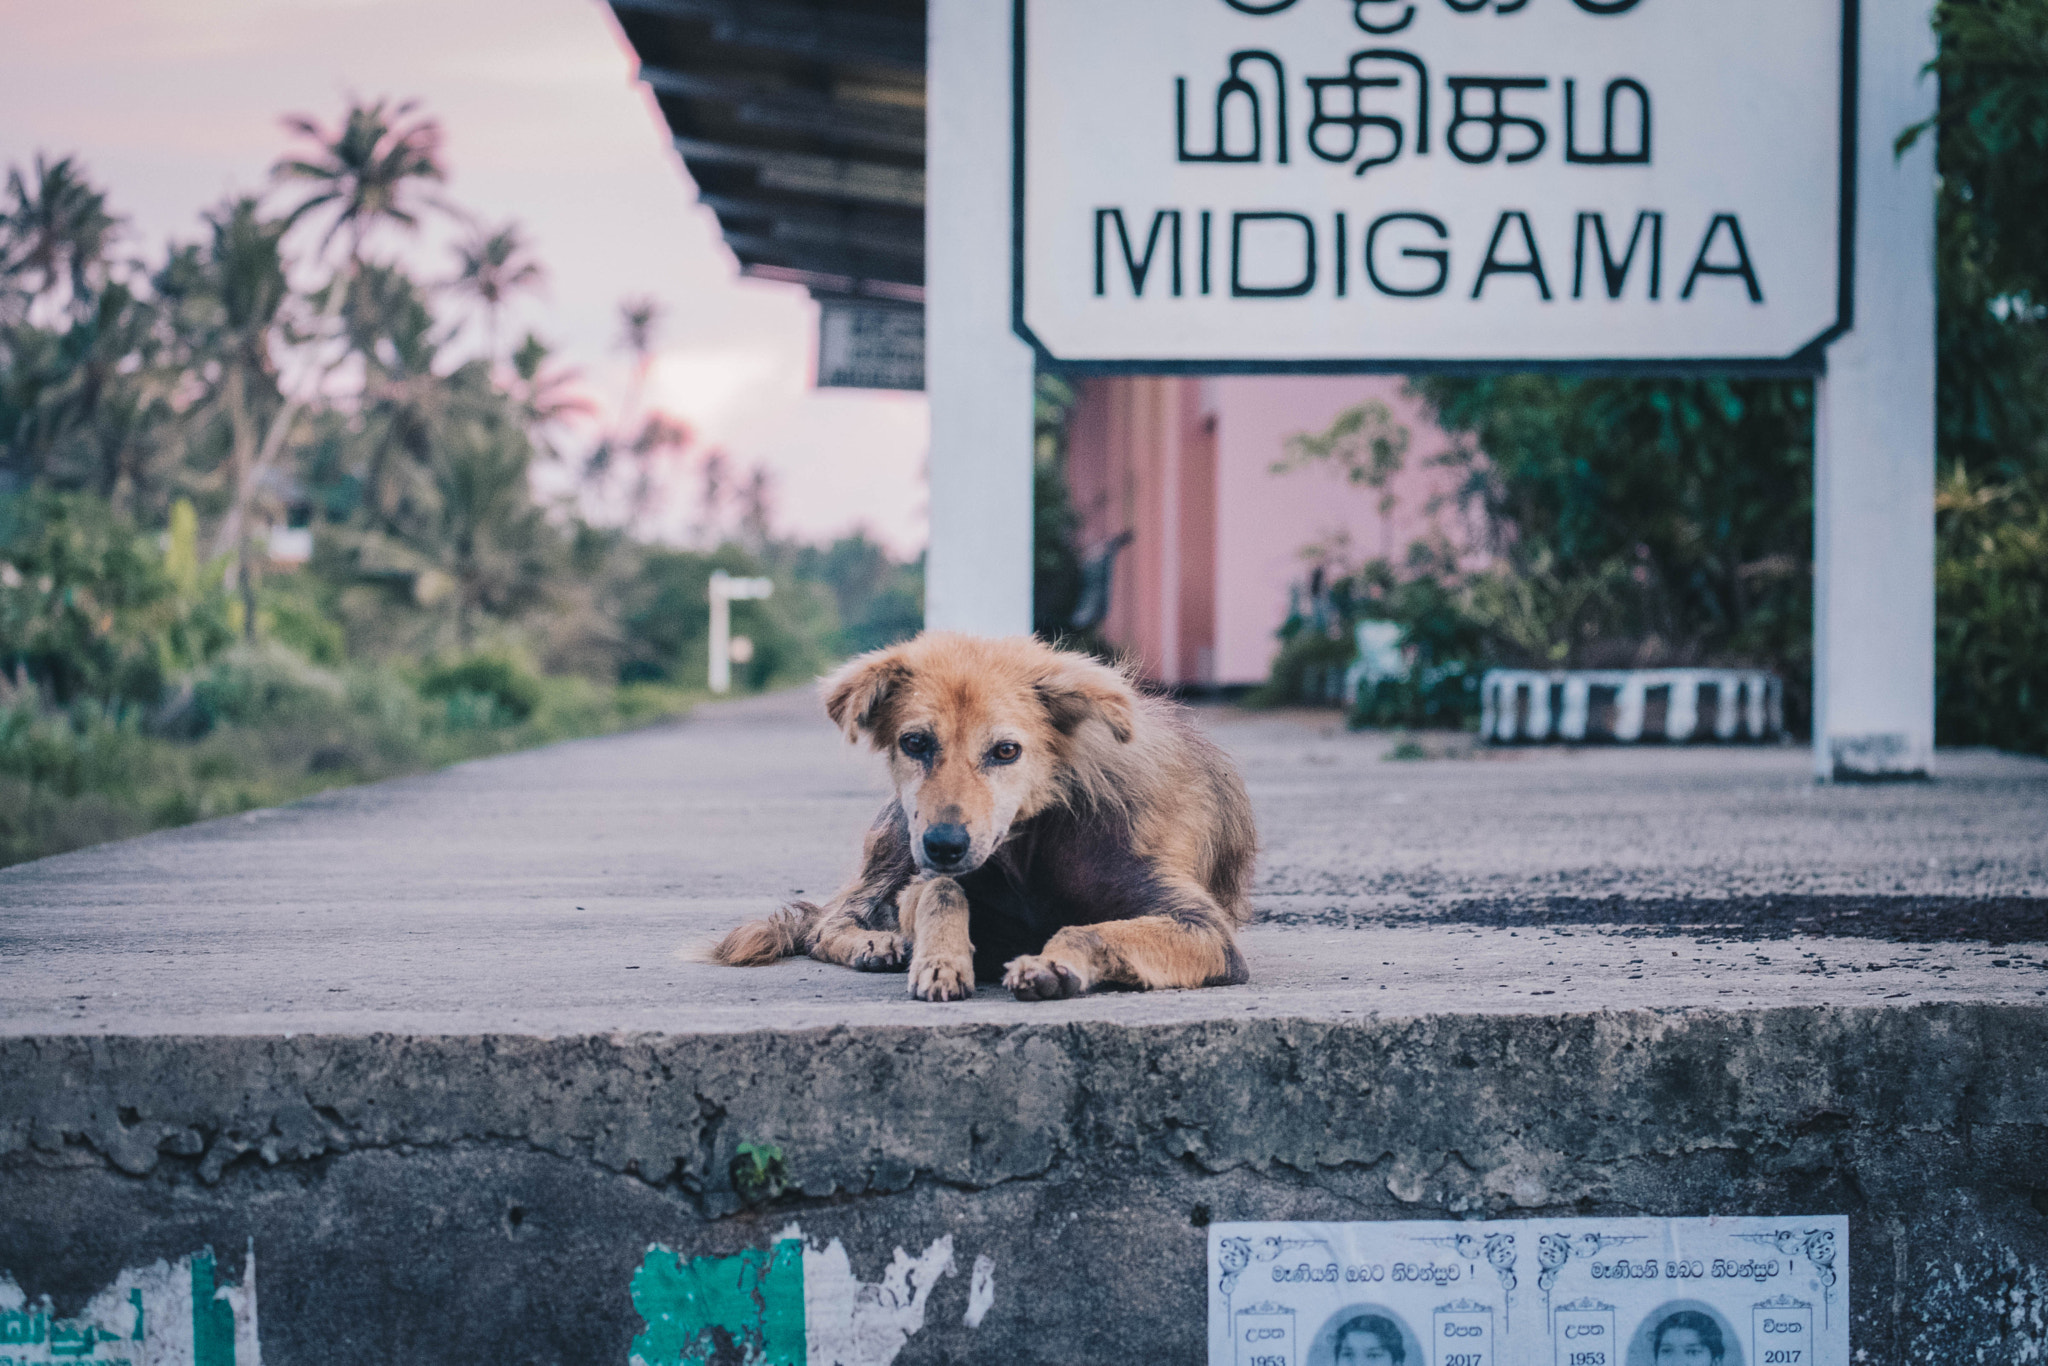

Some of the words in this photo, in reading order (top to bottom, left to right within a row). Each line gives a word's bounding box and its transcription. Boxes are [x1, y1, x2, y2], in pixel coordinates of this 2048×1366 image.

[1175, 49, 1652, 176] மிதிகம
[1092, 208, 1765, 304] MIDIGAMA
[1345, 1264, 1385, 1283] ඔබට
[1665, 1260, 1704, 1279] ඔබට
[1443, 1322, 1483, 1337] විපත
[1565, 1324, 1605, 1339] උපත
[1763, 1318, 1802, 1333] විපත
[1245, 1328, 1285, 1343] උපත
[1250, 1355, 1286, 1366] 1953
[1445, 1353, 1483, 1366] 2017
[1569, 1351, 1606, 1366] 1953
[1764, 1350, 1803, 1363] 2017
